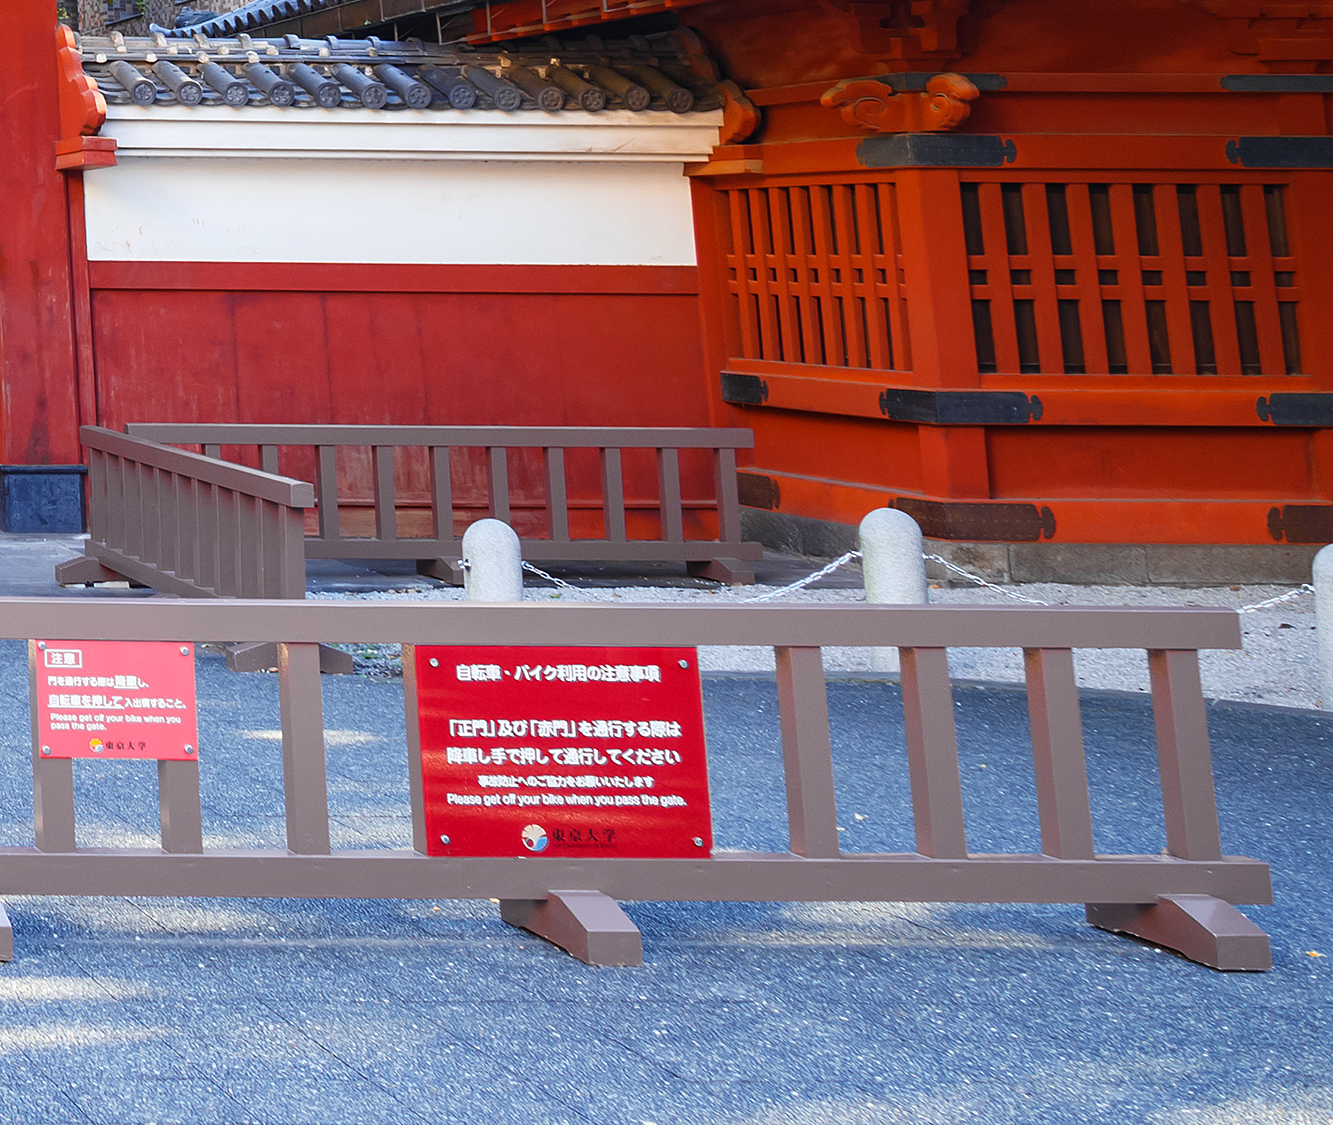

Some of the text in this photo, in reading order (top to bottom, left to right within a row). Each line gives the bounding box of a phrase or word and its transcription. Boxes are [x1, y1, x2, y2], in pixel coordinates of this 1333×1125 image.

[50, 653, 75, 665] 注意
[51, 713, 77, 721] Please
[79, 714, 92, 722] get
[106, 715, 123, 723] your
[143, 715, 165, 723] when
[445, 747, 680, 765] 降車し手で押して通行してください
[447, 793, 482, 805] Please
[484, 794, 502, 806] get
[503, 793, 516, 805] off
[517, 795, 541, 806] your
[541, 794, 564, 805] bike
[565, 794, 593, 805] when
[594, 796, 615, 806] you
[615, 796, 641, 806] pass
[641, 794, 661, 805] the
